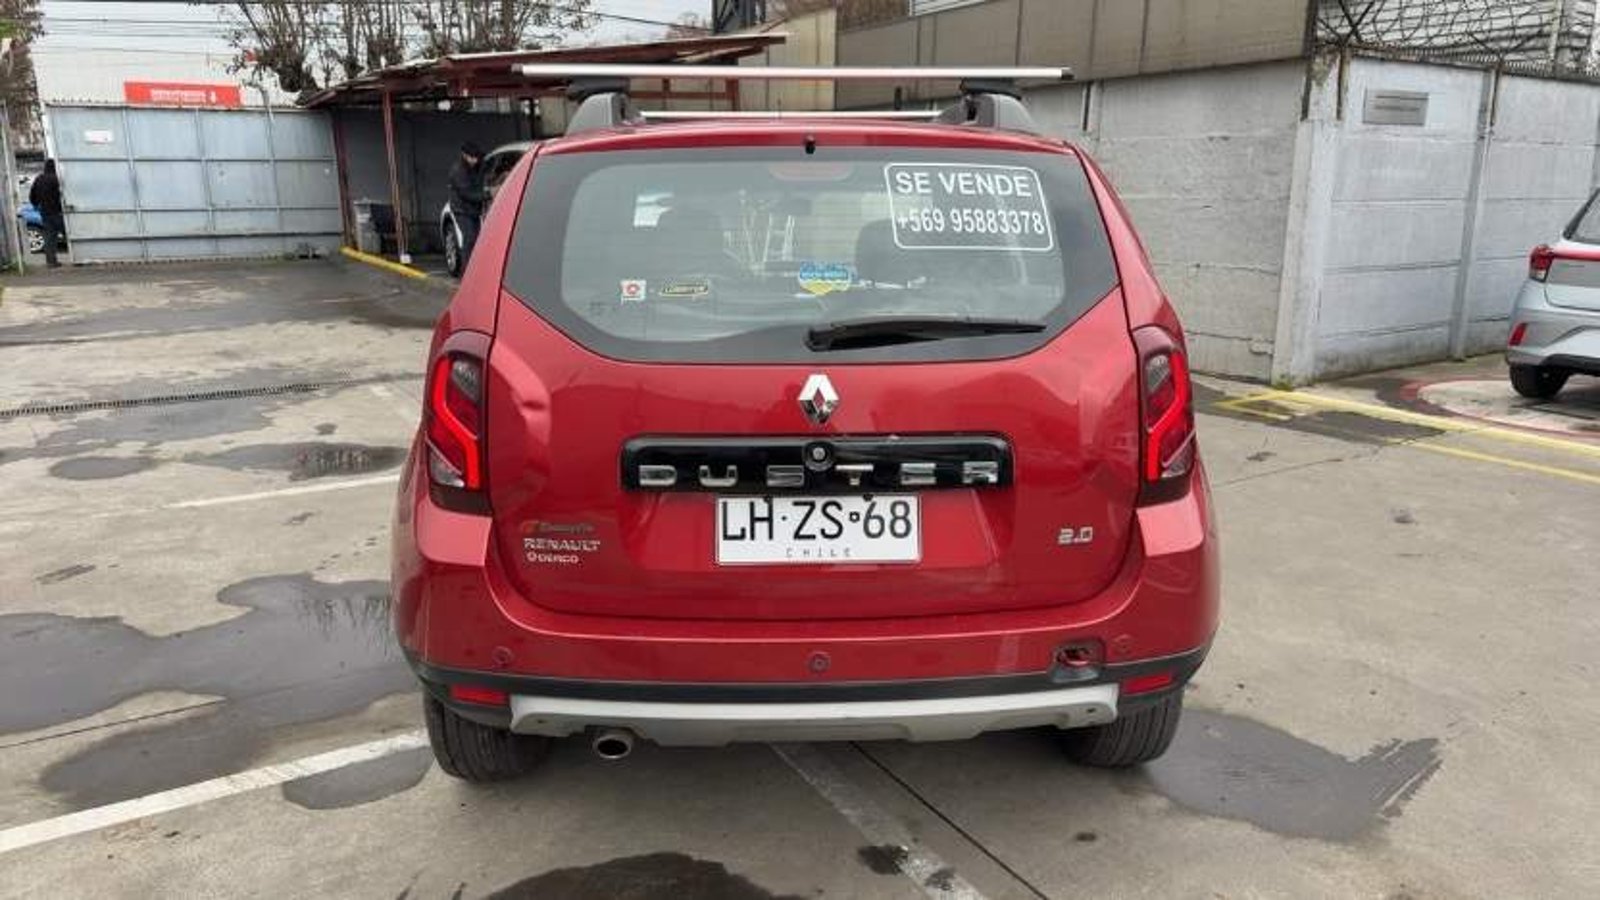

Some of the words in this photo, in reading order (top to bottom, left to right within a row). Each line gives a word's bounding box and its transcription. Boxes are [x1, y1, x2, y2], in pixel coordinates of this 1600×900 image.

[895, 171, 932, 194] SE
[937, 172, 1032, 198] VENDE
[897, 207, 946, 233] +569
[949, 208, 1046, 235] 95883378
[638, 460, 999, 488] DUSTER
[523, 537, 601, 553] RENAULT
[1057, 526, 1094, 546] 2.0
[785, 546, 852, 558] CHILE
